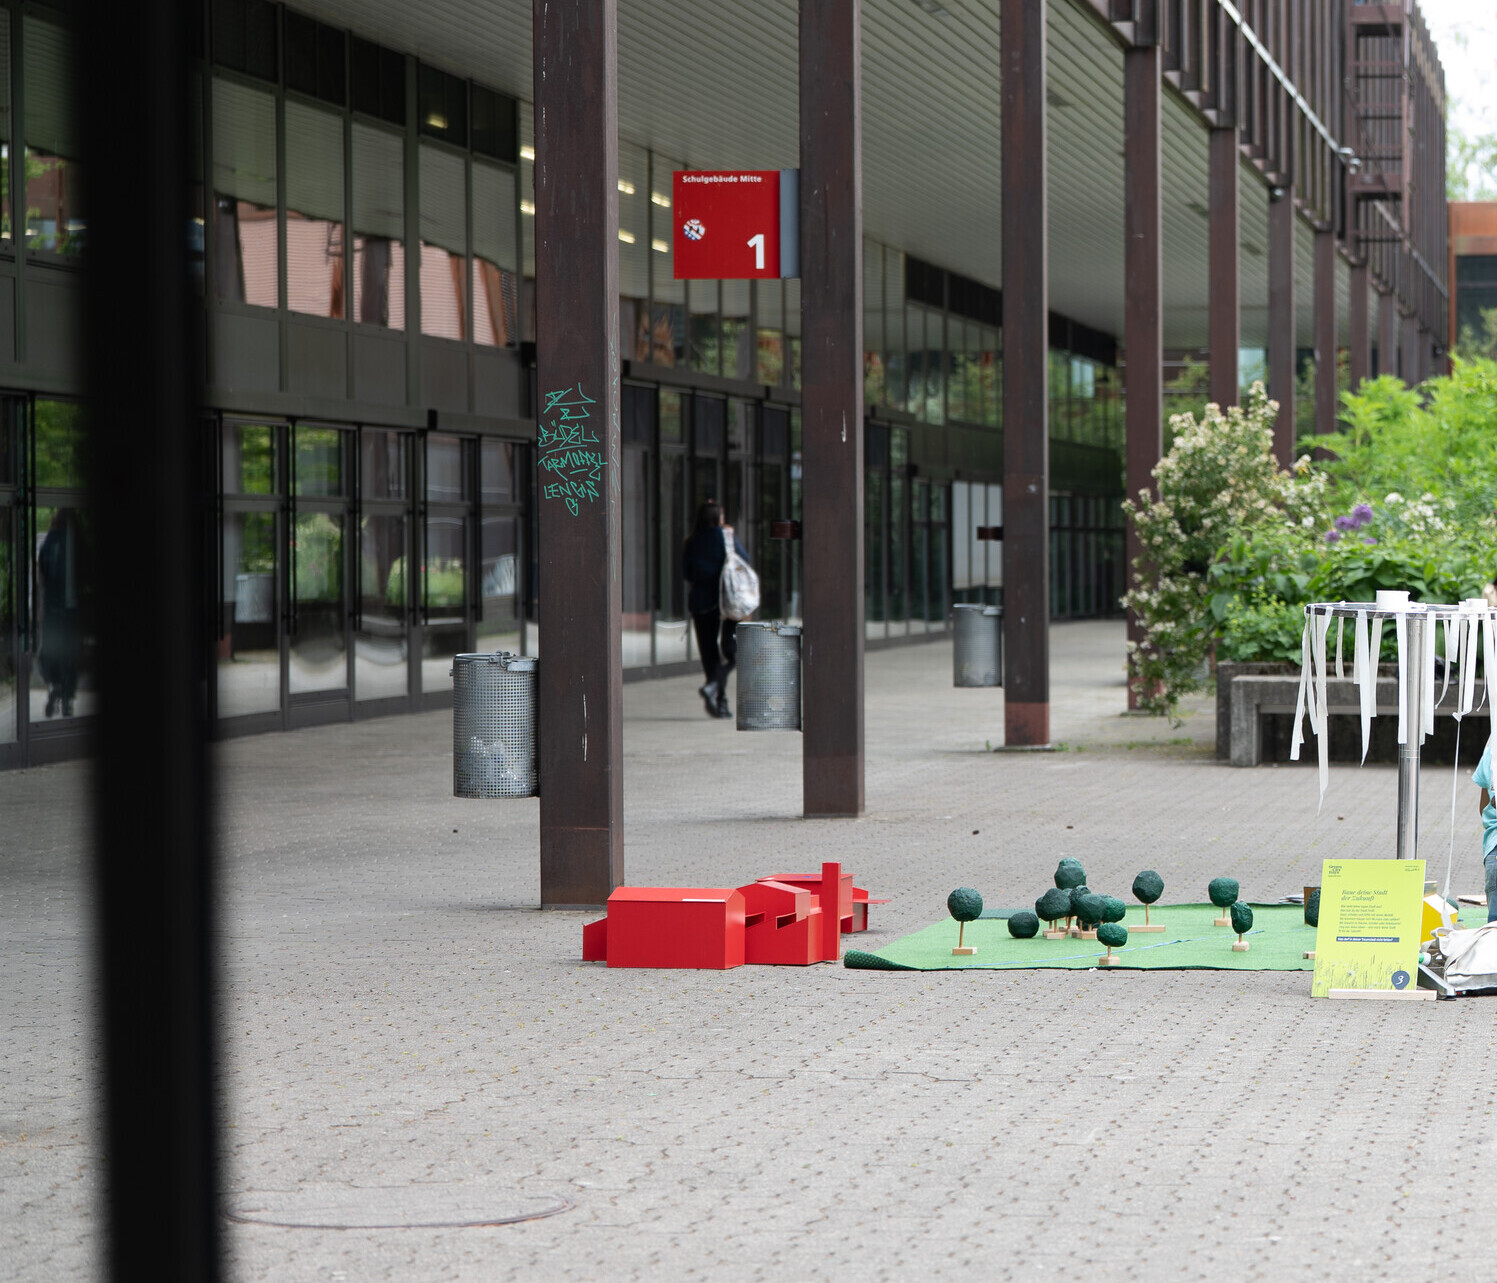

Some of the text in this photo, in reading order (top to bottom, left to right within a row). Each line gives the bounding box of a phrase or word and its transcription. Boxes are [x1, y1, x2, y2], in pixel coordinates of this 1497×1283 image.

[682, 175, 762, 184] Schulgebäude Mitte
[746, 233, 765, 270] 1
